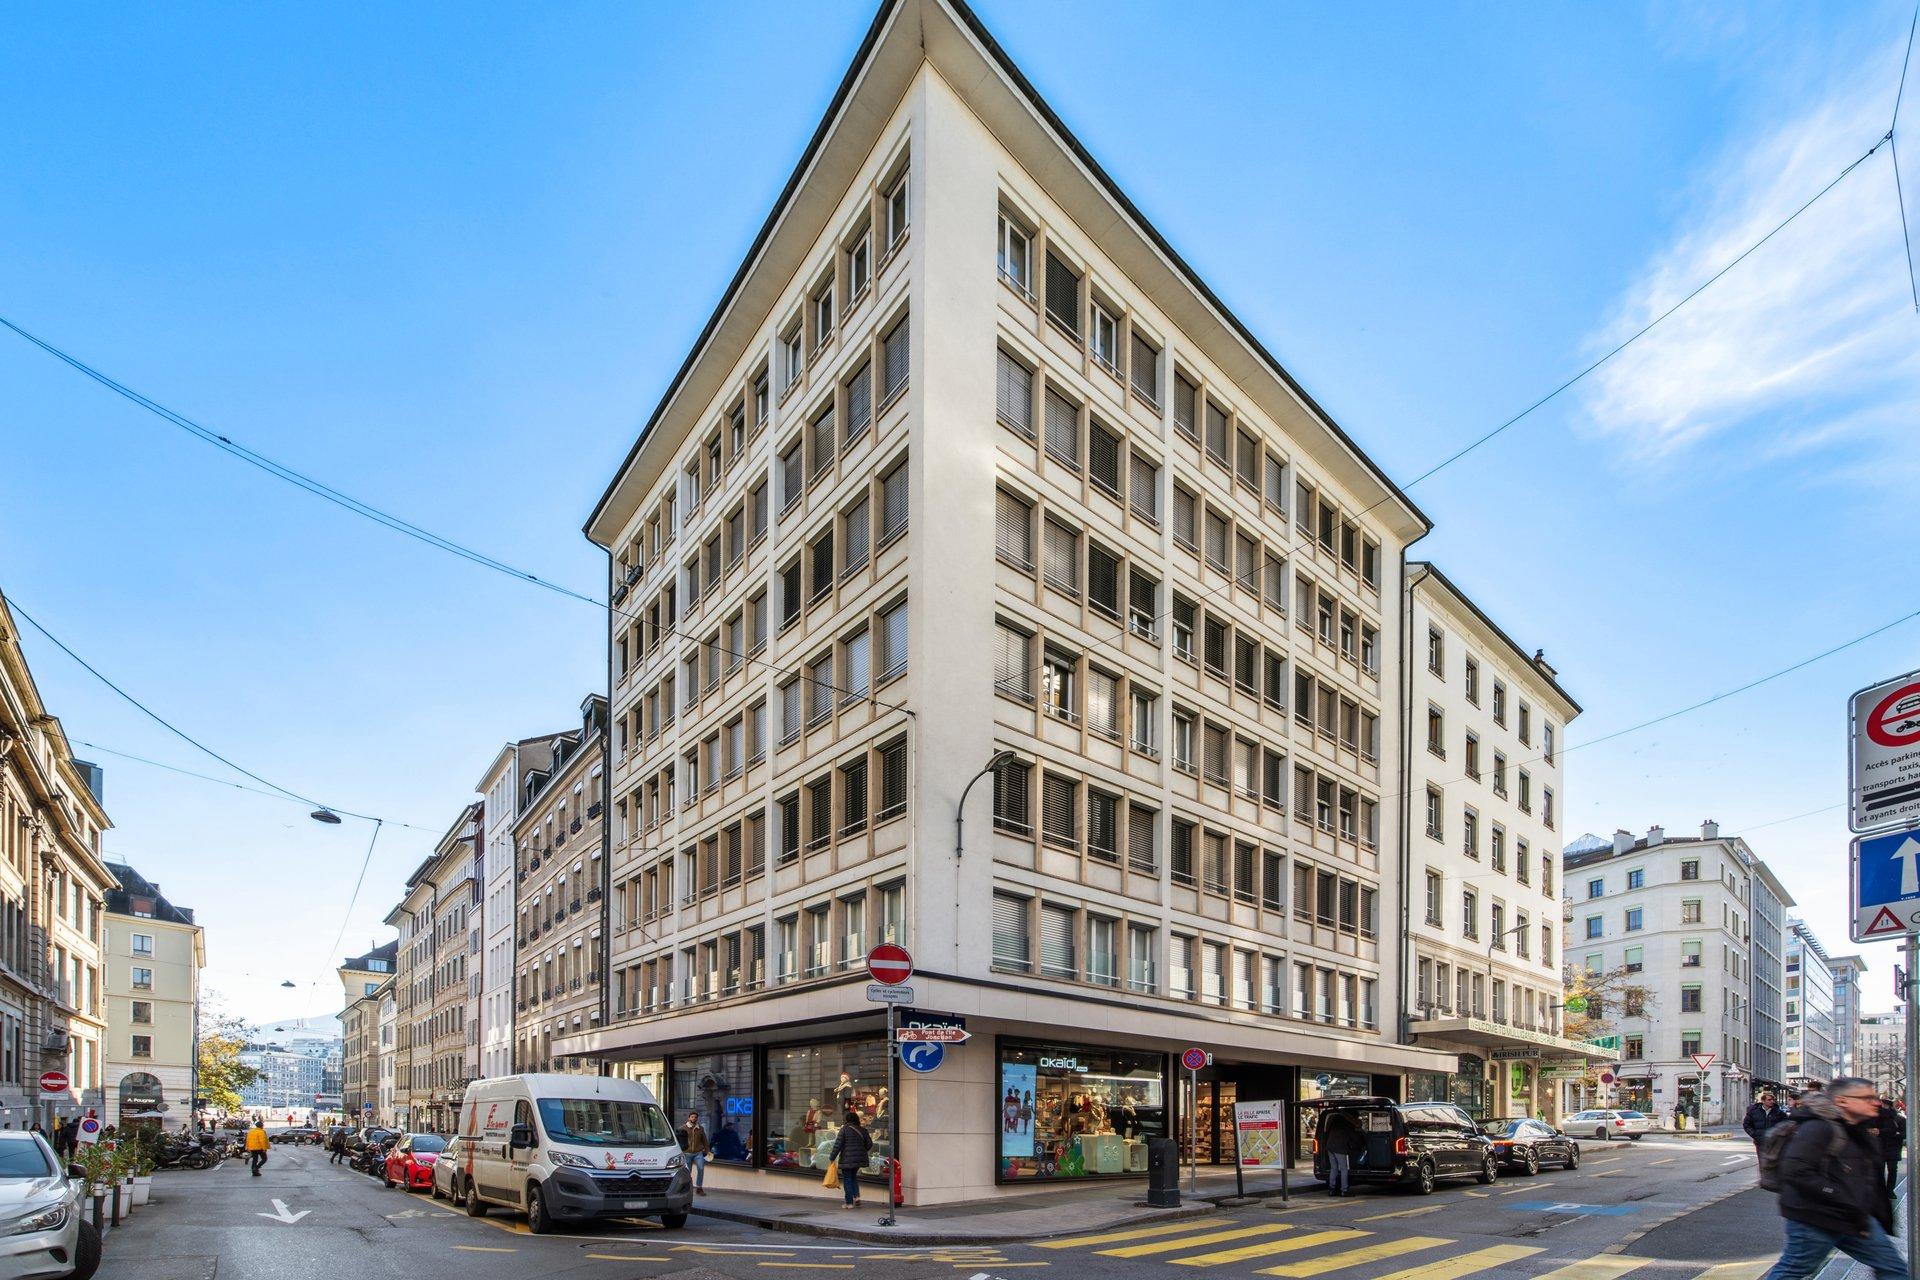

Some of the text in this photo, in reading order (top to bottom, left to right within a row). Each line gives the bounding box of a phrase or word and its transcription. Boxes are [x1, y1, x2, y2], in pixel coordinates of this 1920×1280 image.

[1865, 751, 1920, 771] Accès parkin
[1863, 776, 1906, 792] transports
[1858, 815, 1867, 823] et
[1869, 809, 1897, 821] ayants
